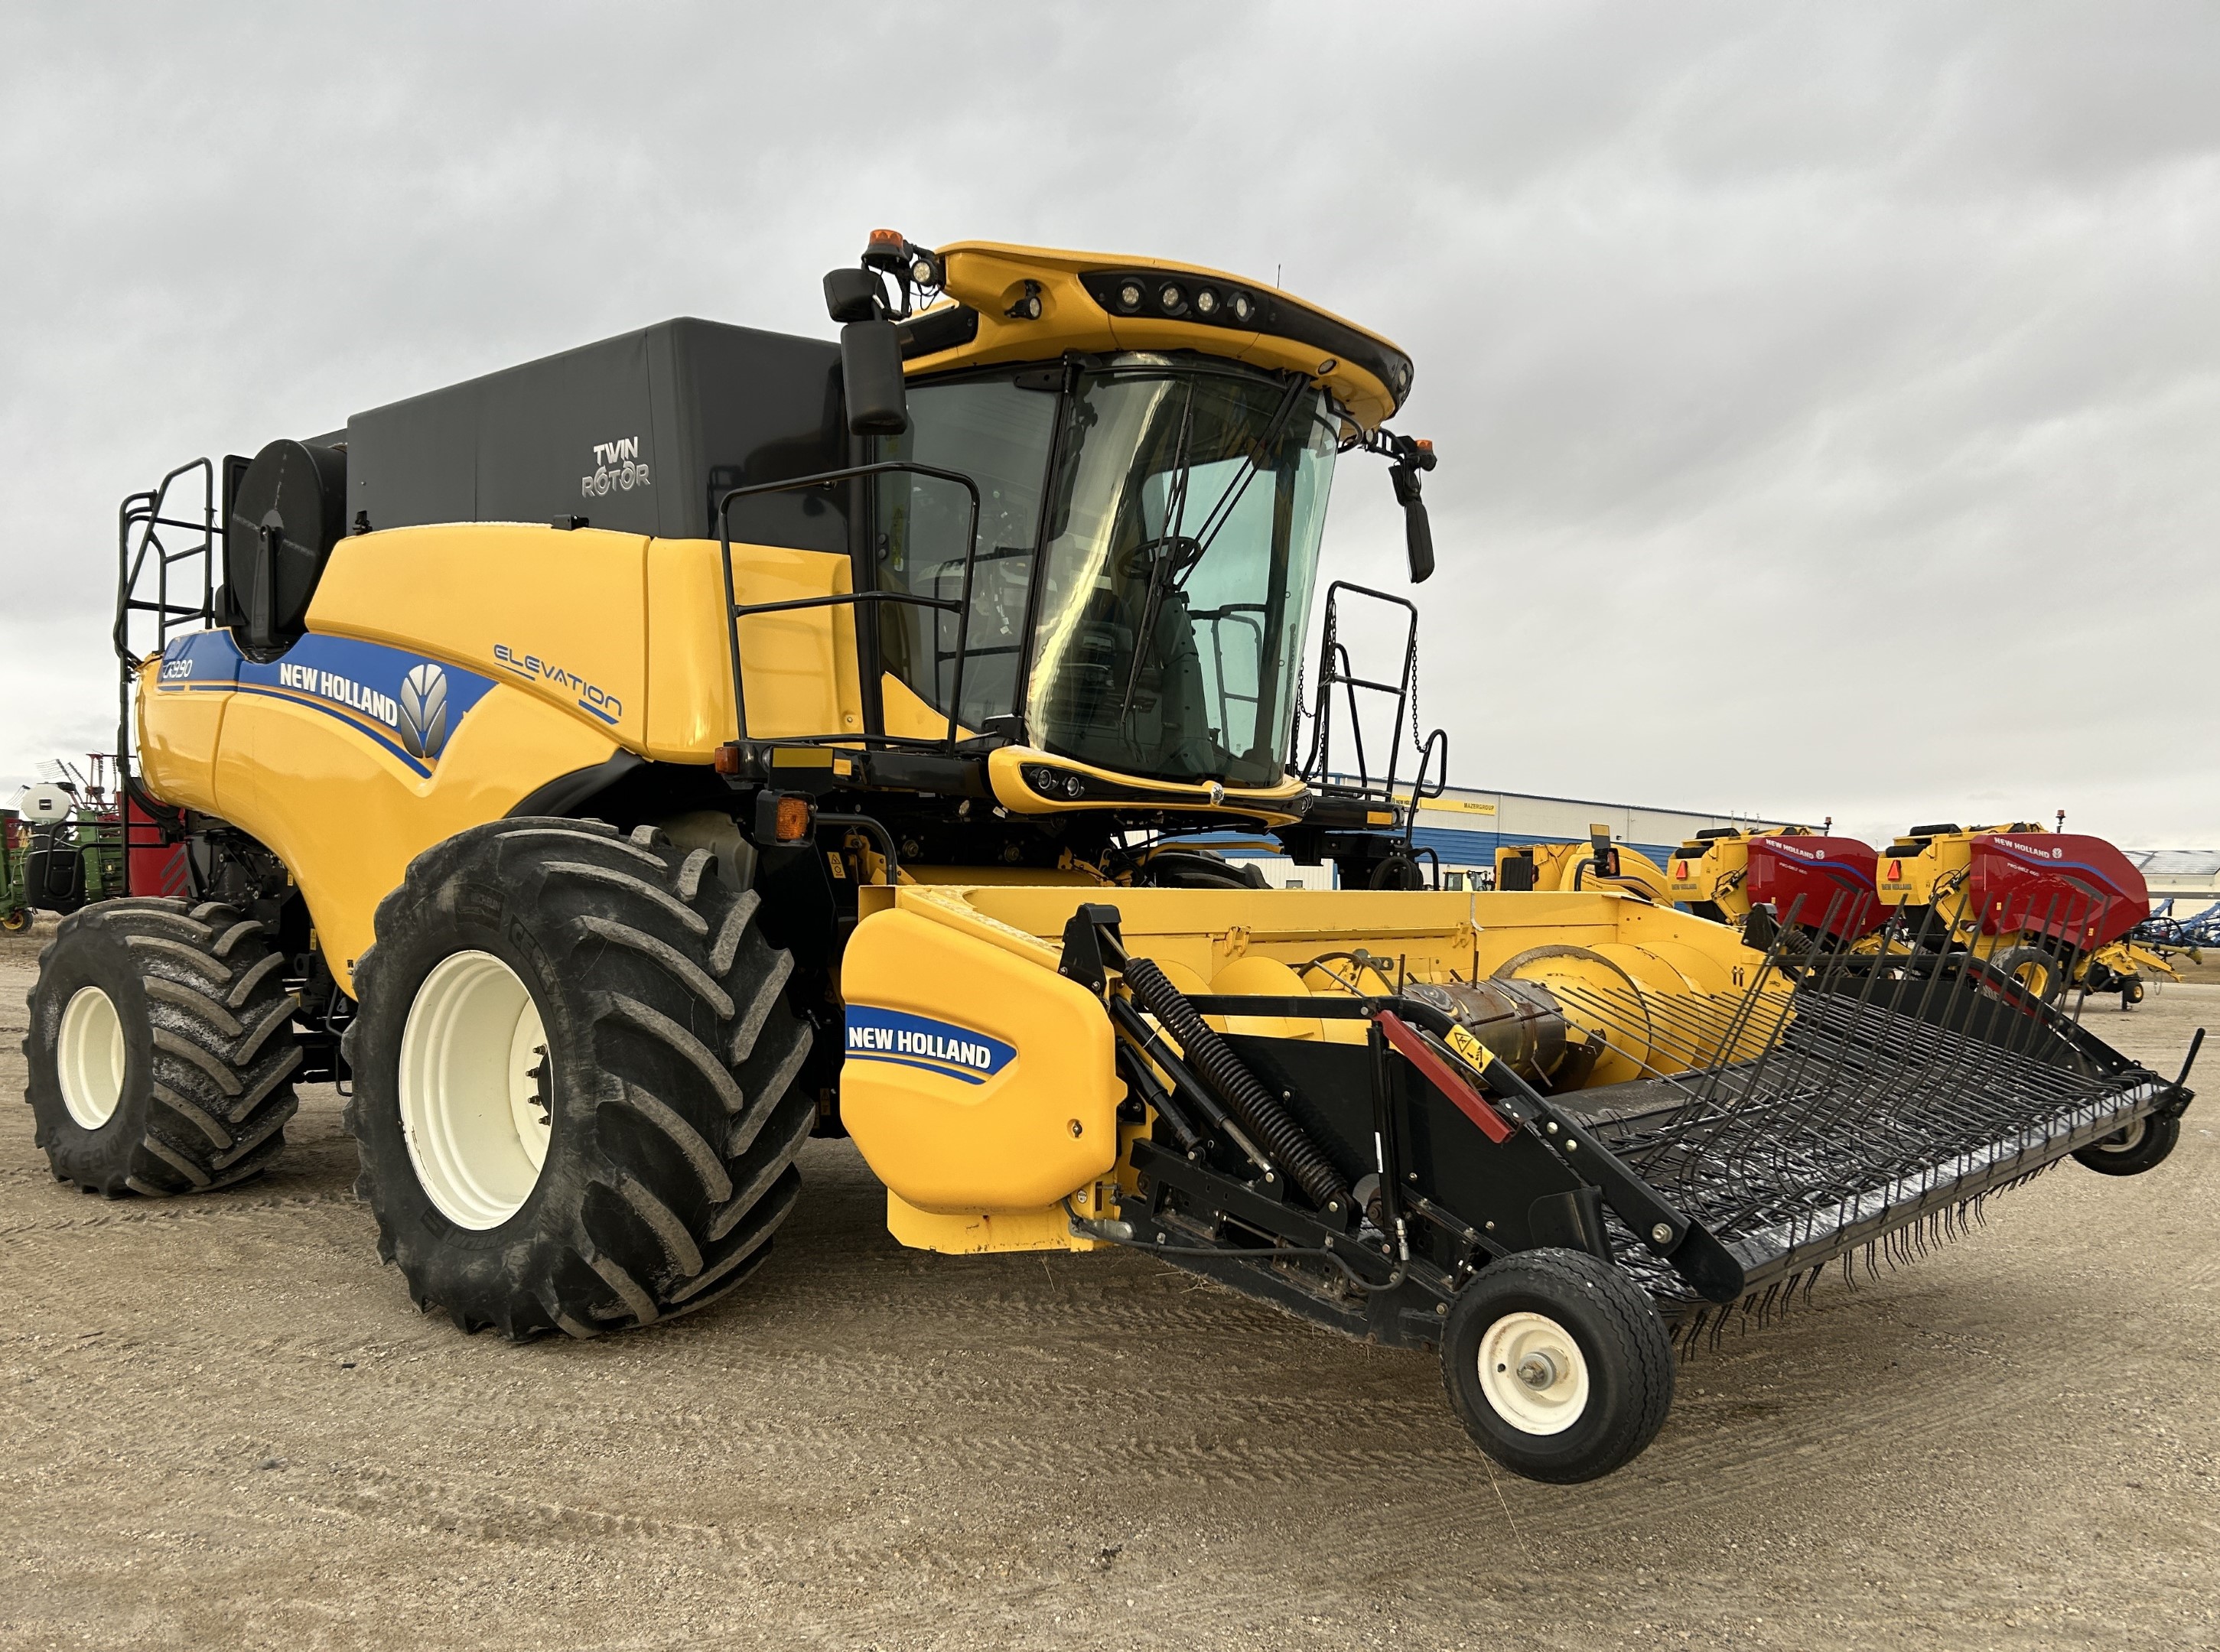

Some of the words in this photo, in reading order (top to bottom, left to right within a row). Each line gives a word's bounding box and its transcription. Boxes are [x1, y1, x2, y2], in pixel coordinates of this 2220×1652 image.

[593, 436, 639, 466] TWIN
[581, 460, 651, 498] ROTOR
[280, 662, 317, 692] NEW
[321, 671, 398, 727] HOLLAND
[493, 644, 622, 717] ELEVATION
[1765, 838, 1782, 849] NEW
[1782, 844, 1814, 860] HOLLAND
[1994, 837, 2013, 848] NEW
[2013, 842, 2050, 858] HOLLAND
[848, 1026, 894, 1050] NEW
[897, 1029, 991, 1070] HOLLAND
